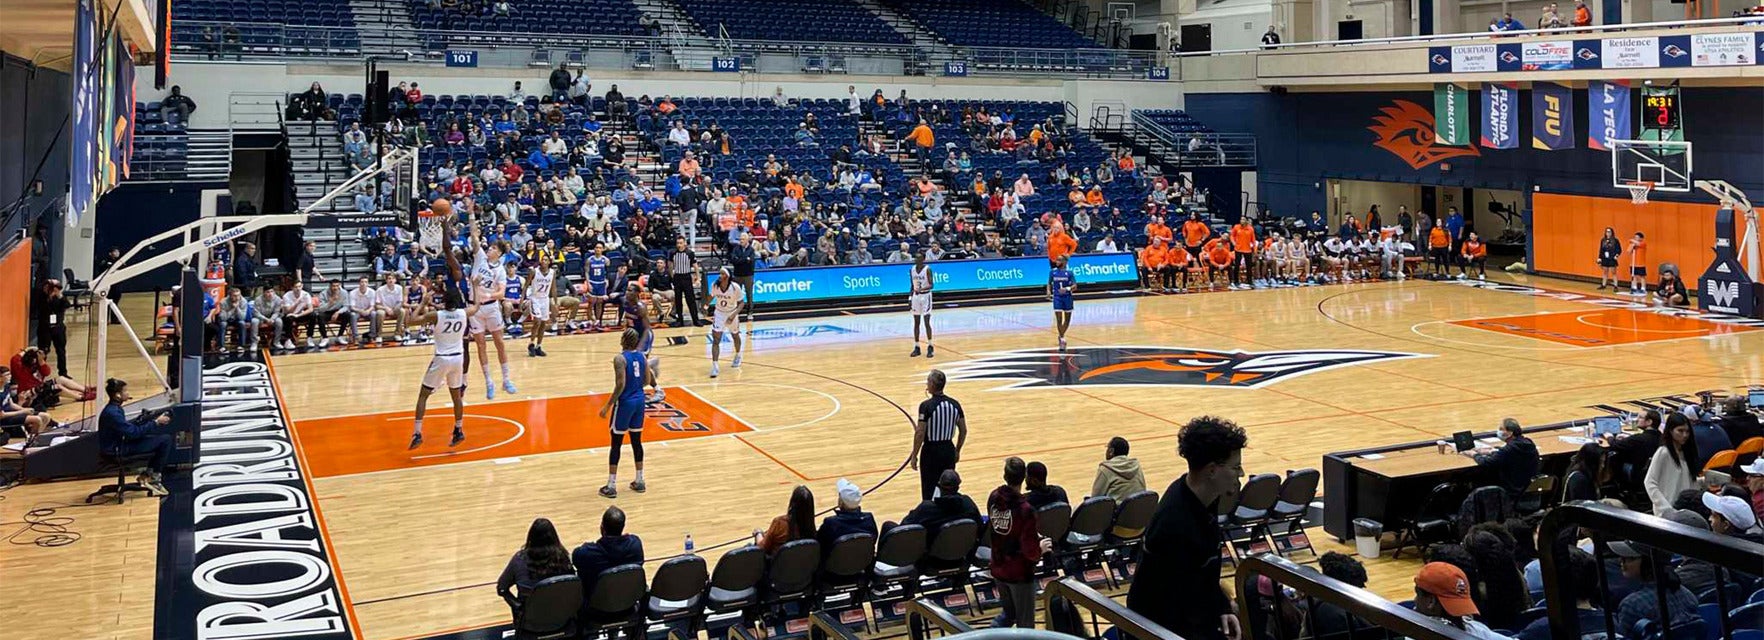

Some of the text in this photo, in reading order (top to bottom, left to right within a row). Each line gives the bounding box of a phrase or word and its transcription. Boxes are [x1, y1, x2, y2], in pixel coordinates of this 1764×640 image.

[1453, 46, 1495, 54] COURTYARD
[1609, 39, 1651, 47] Residence
[453, 54, 471, 63] 101
[717, 60, 735, 69] 102
[948, 65, 964, 74] 103
[1152, 69, 1166, 77] 104
[1647, 97, 1672, 107] 19:31
[1447, 84, 1456, 144] CHARLOTTE
[1490, 84, 1500, 146] ATLANTIC
[1500, 89, 1510, 141] FLORIDA
[1544, 95, 1561, 136] FIU
[1603, 83, 1616, 148] LA TECH
[203, 227, 246, 247] Schelde
[976, 268, 1024, 281] Concerts
[842, 275, 880, 291] Sports
[442, 321, 462, 334] 20
[632, 360, 641, 378] 3
[192, 362, 346, 640] ROADRUNNERS
